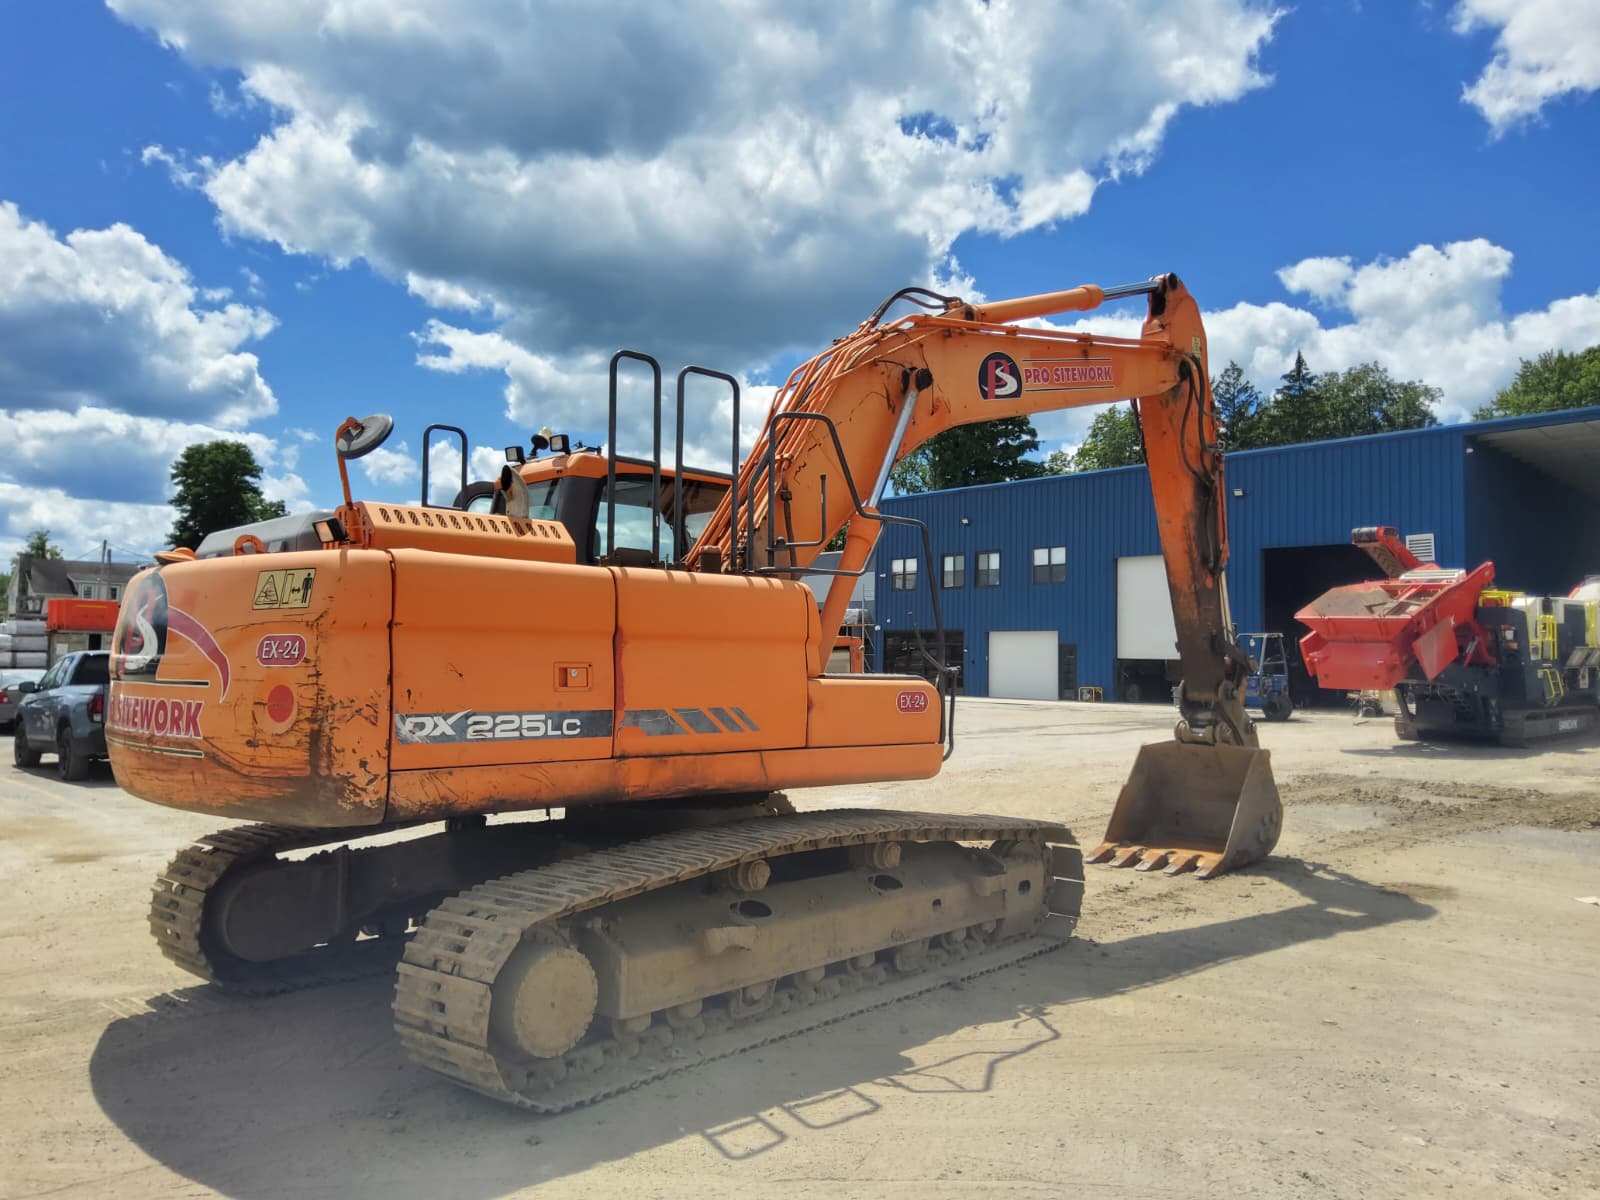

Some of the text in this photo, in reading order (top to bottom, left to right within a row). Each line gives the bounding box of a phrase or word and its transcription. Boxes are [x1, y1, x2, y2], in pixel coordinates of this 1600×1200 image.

[1024, 366, 1113, 384] PRO SITEWORK
[262, 640, 300, 659] EX-24
[900, 695, 925, 708] EX-24
